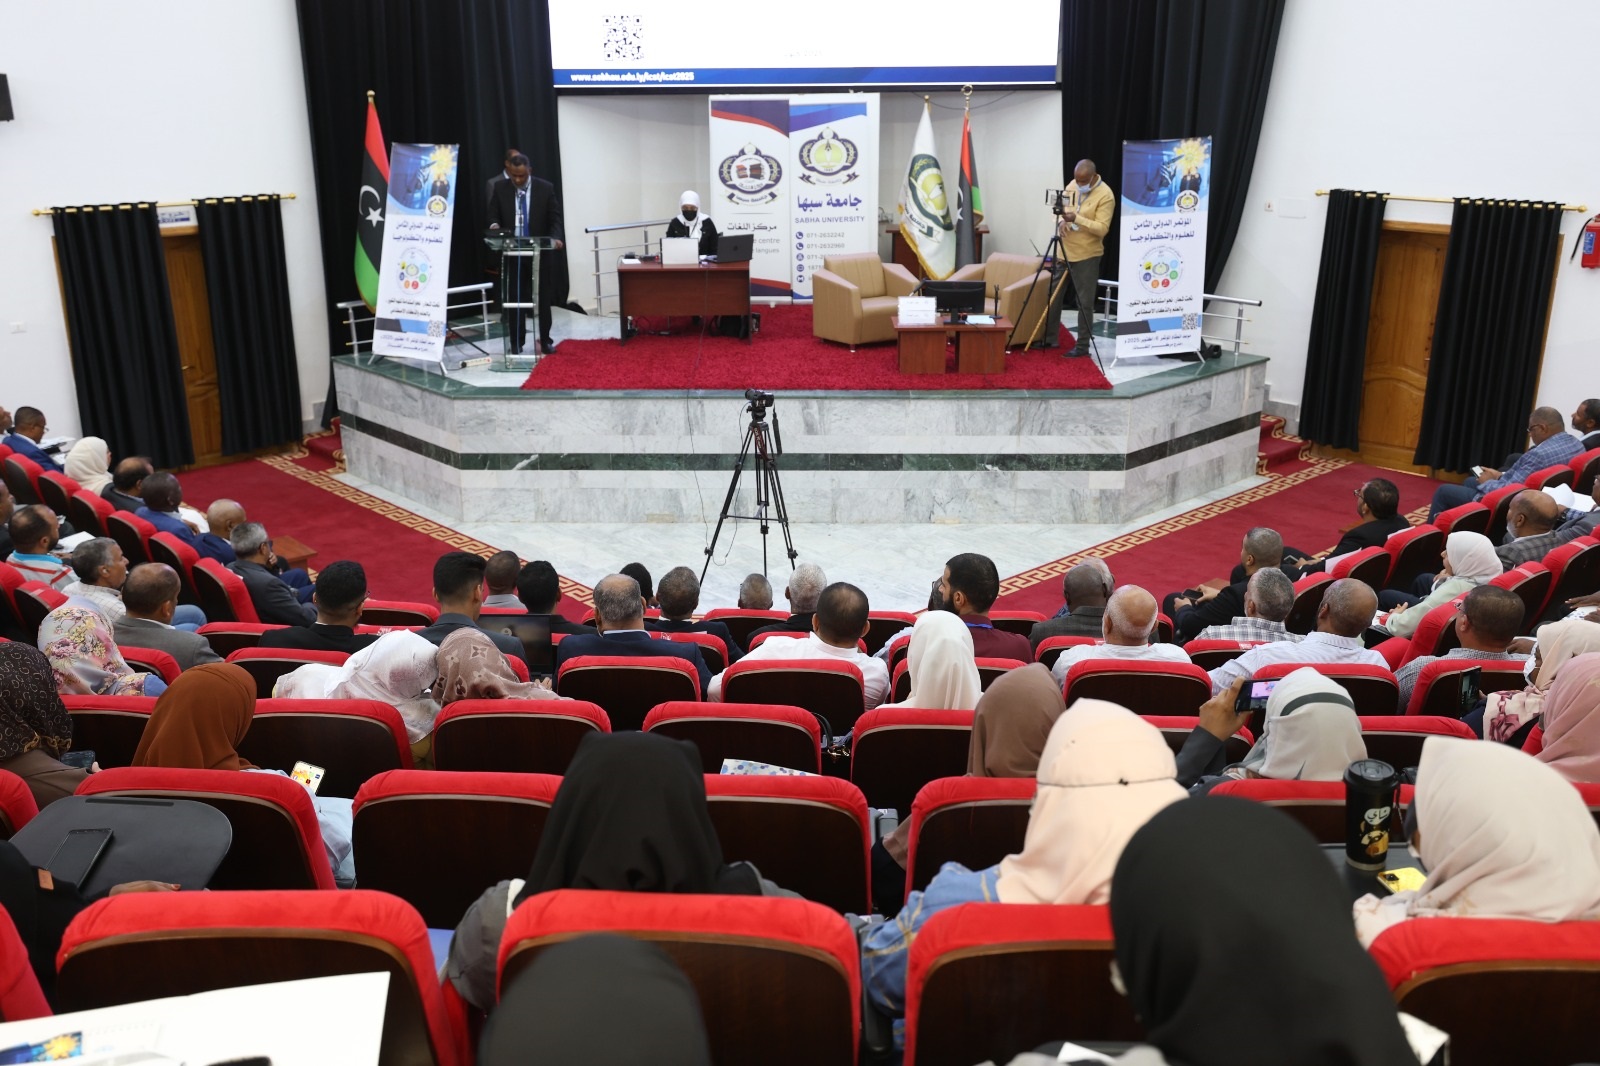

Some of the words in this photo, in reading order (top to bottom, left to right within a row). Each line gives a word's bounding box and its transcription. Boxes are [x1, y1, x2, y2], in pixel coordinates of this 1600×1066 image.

[797, 194, 823, 212] سبها
[826, 193, 862, 211] جامعة
[727, 222, 751, 231] اللغات
[752, 222, 777, 231] مركز
[1133, 219, 1153, 231] الثامن
[1153, 219, 1173, 230] الدولي
[1173, 217, 1192, 228] المؤتمر
[755, 247, 780, 255] langues
